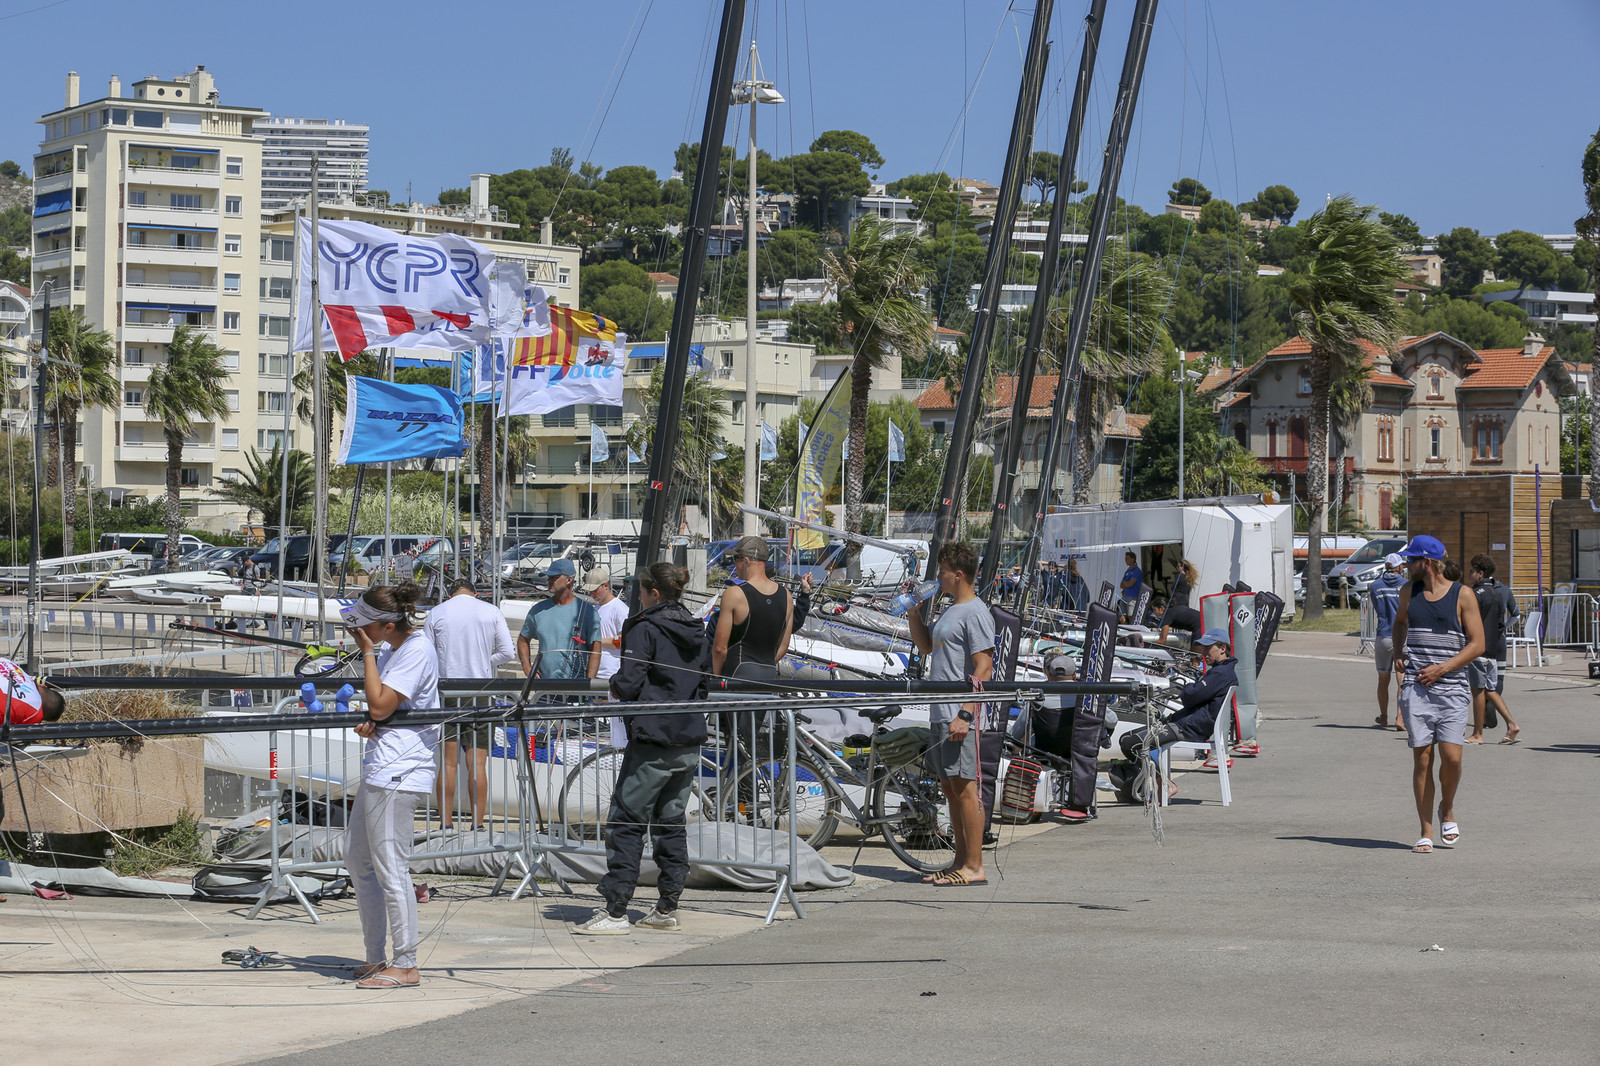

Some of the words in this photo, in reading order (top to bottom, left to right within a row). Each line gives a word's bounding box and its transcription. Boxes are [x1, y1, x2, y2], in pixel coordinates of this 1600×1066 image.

[318, 241, 483, 298] YCPR
[367, 409, 457, 425] NACRA
[396, 422, 429, 438] 17
[346, 614, 359, 625] ZK
[1237, 609, 1249, 623] GP
